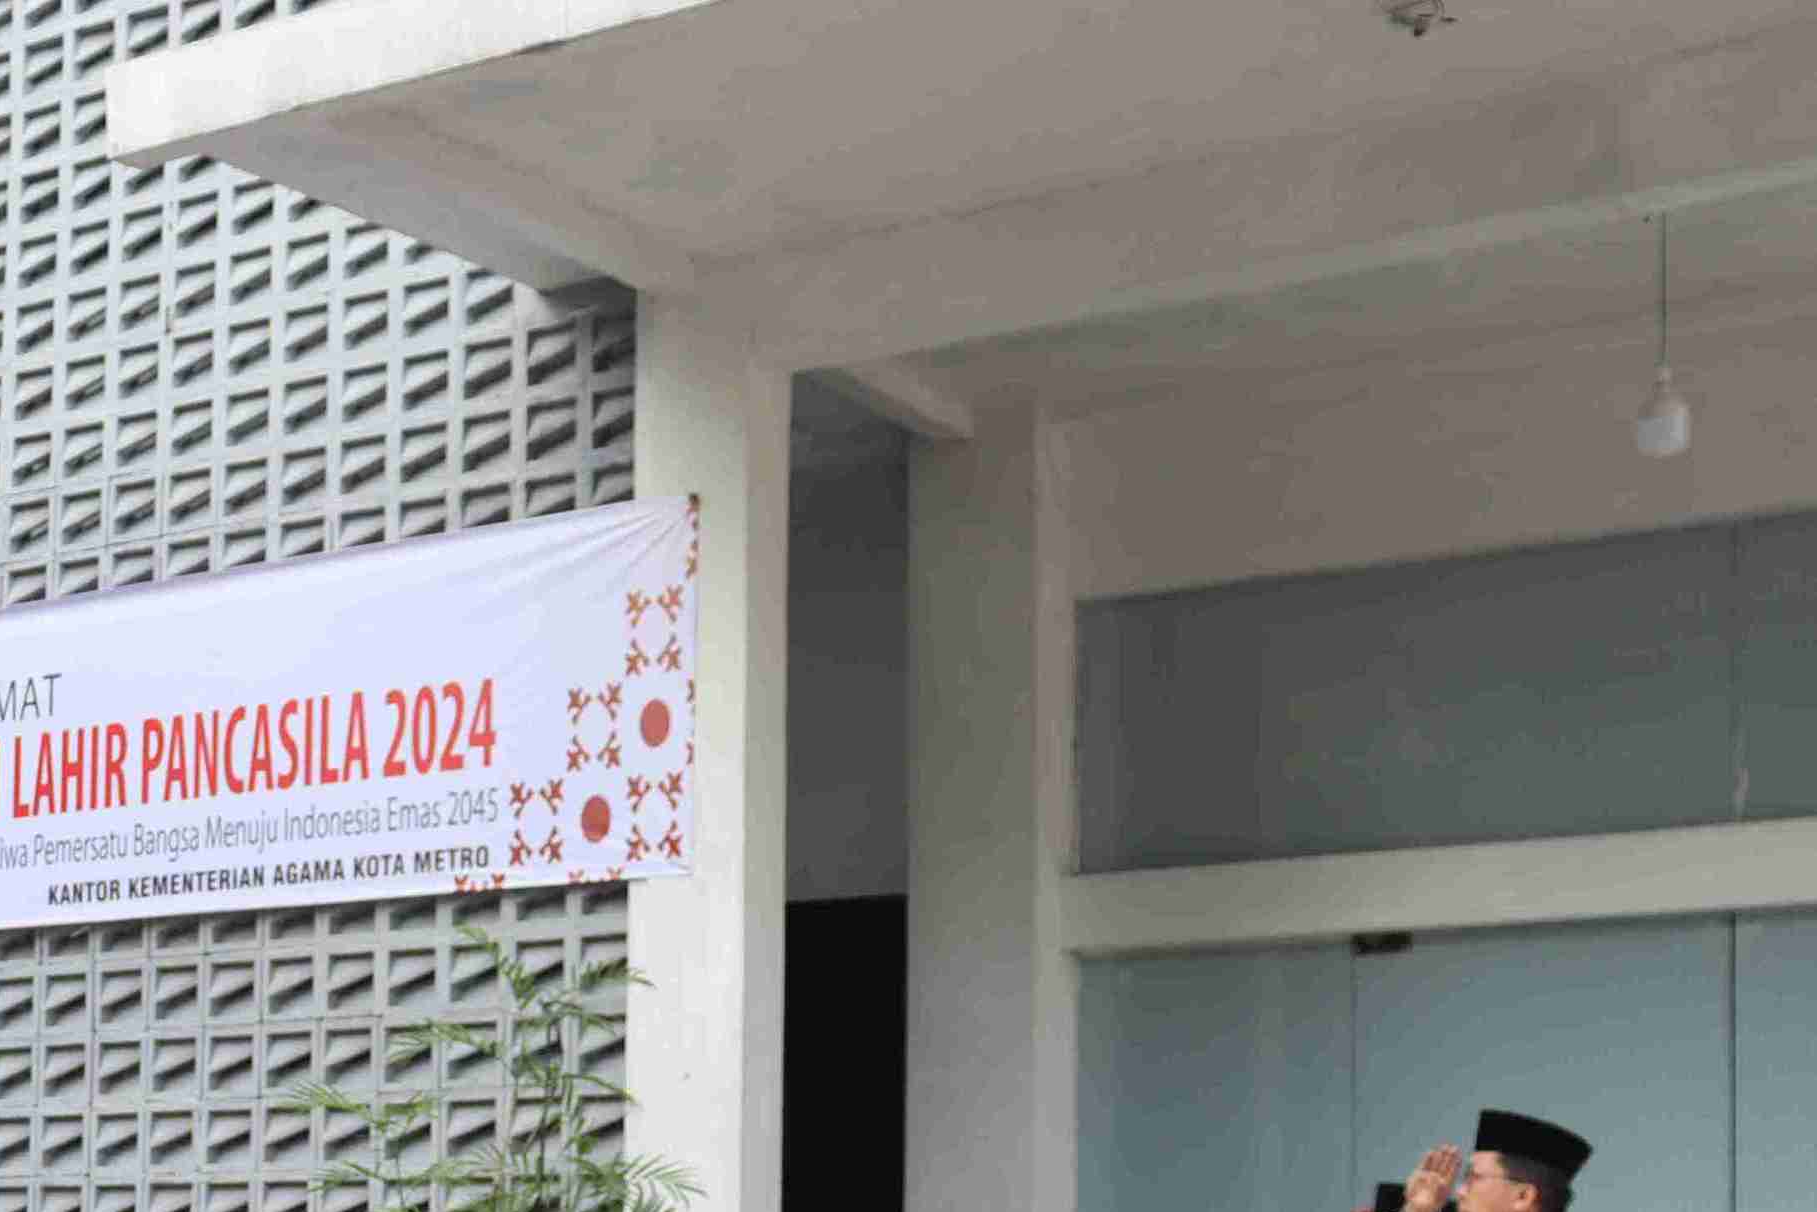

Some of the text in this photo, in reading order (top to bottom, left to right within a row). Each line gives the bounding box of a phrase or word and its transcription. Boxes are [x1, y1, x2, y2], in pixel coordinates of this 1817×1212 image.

[13, 722, 128, 819] LAHIR
[141, 690, 370, 804] PANCASILA
[383, 677, 497, 777] 2024
[34, 829, 128, 868] Pemersatu
[133, 822, 200, 862] Bangsa
[205, 810, 278, 854] Menuju
[284, 799, 380, 841] Indonesia
[387, 796, 441, 832] Emas
[447, 787, 499, 826] 2045
[48, 845, 490, 906] KANTOR KEMENTERIAN AGAMA KOTA METRO
